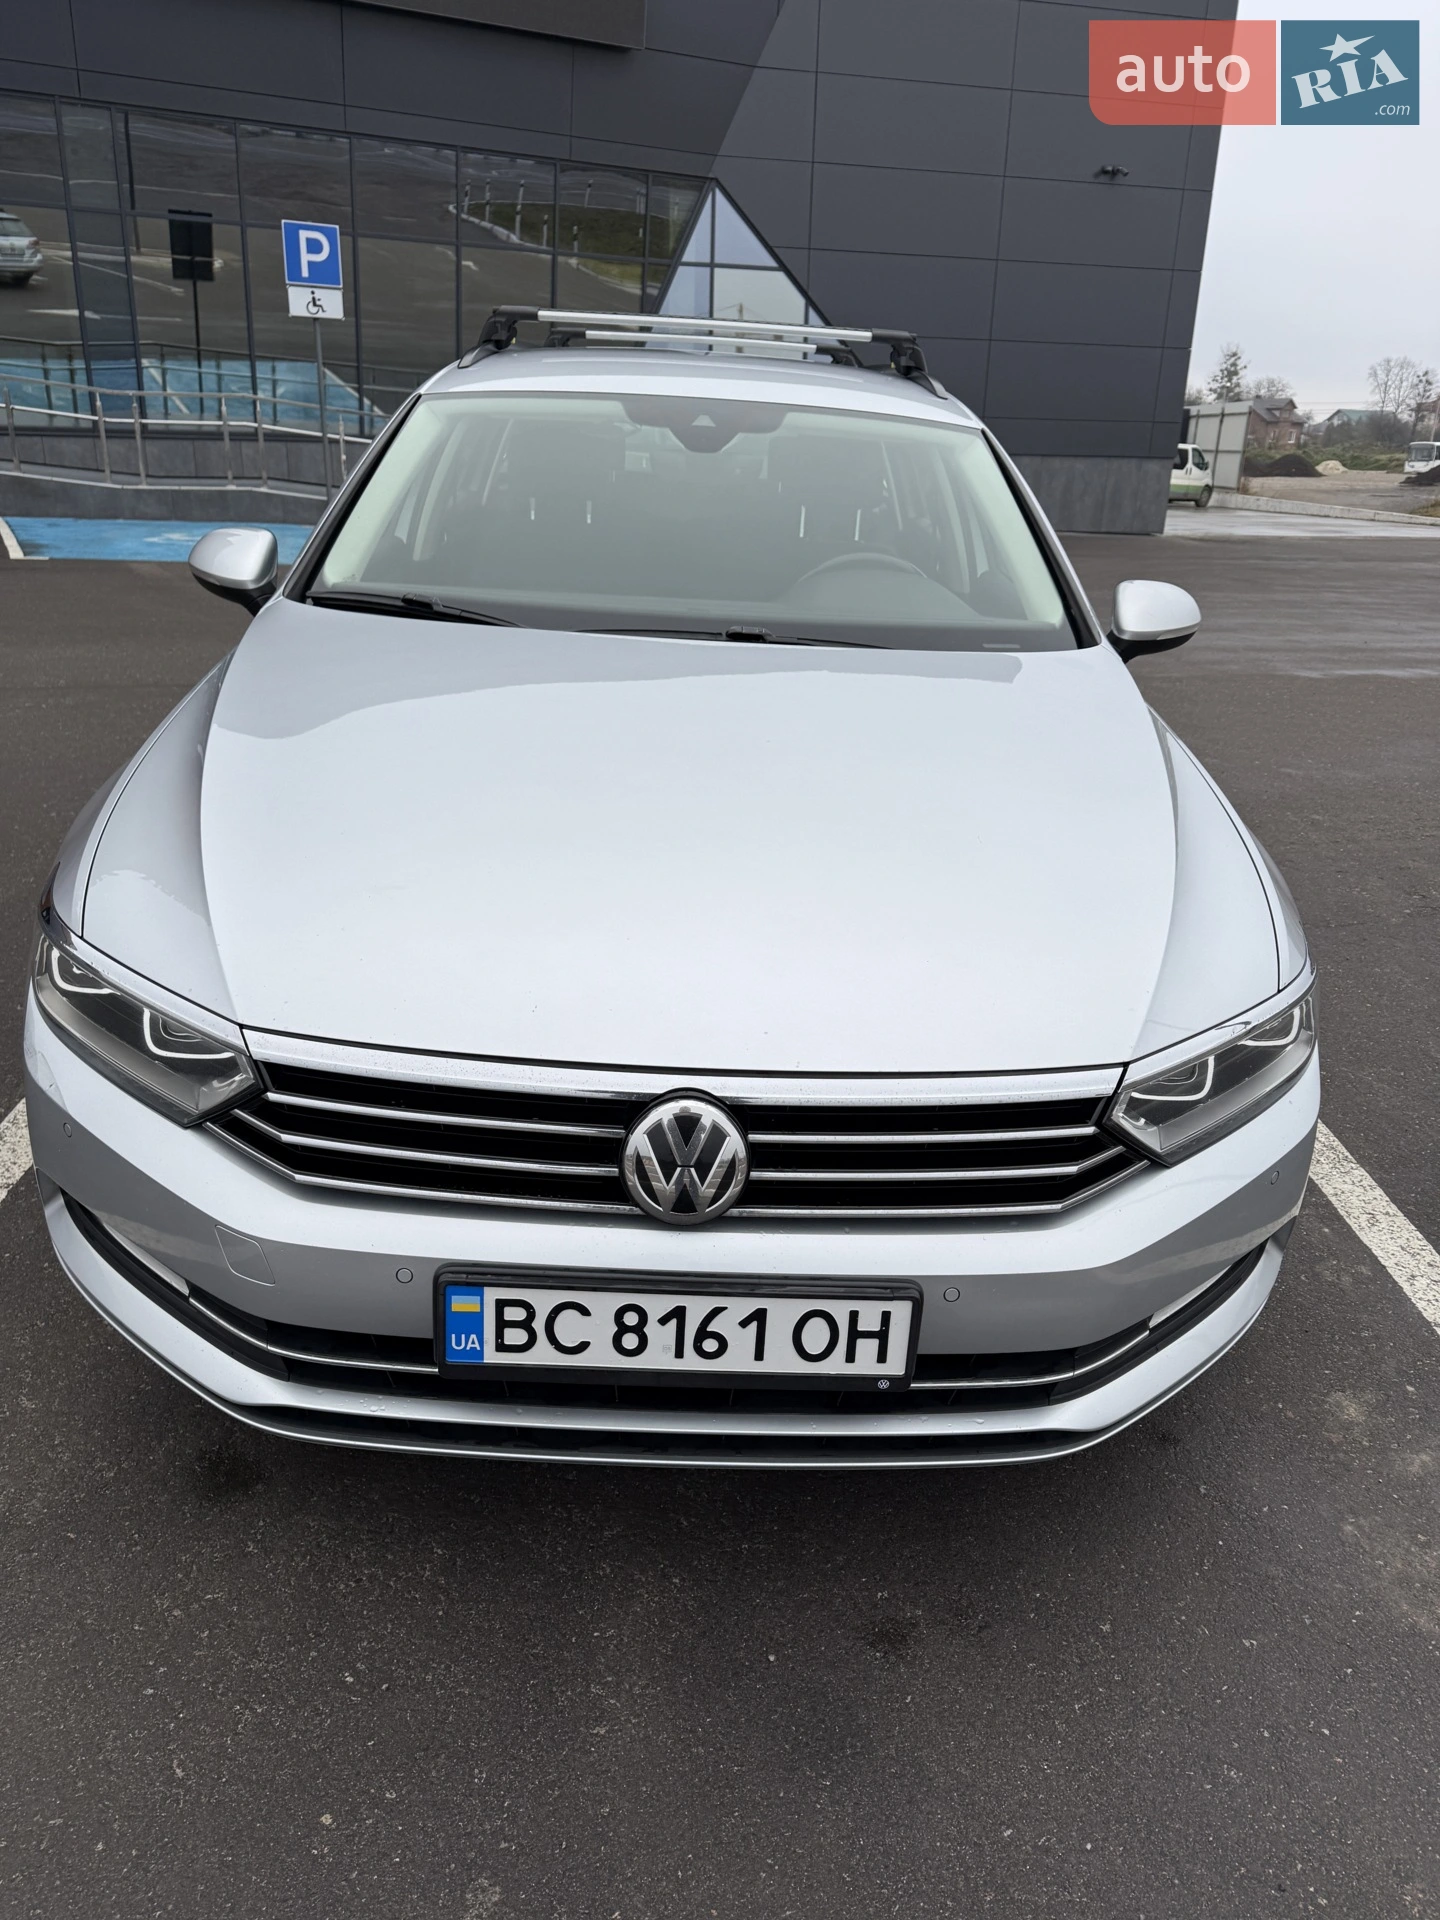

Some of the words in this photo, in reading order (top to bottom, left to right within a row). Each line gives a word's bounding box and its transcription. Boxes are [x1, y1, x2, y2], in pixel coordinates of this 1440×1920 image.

[298, 229, 330, 278] P
[451, 1333, 481, 1351] UA
[494, 1298, 592, 1355] BC
[612, 1303, 768, 1362] 8161
[792, 1308, 892, 1364] OH
